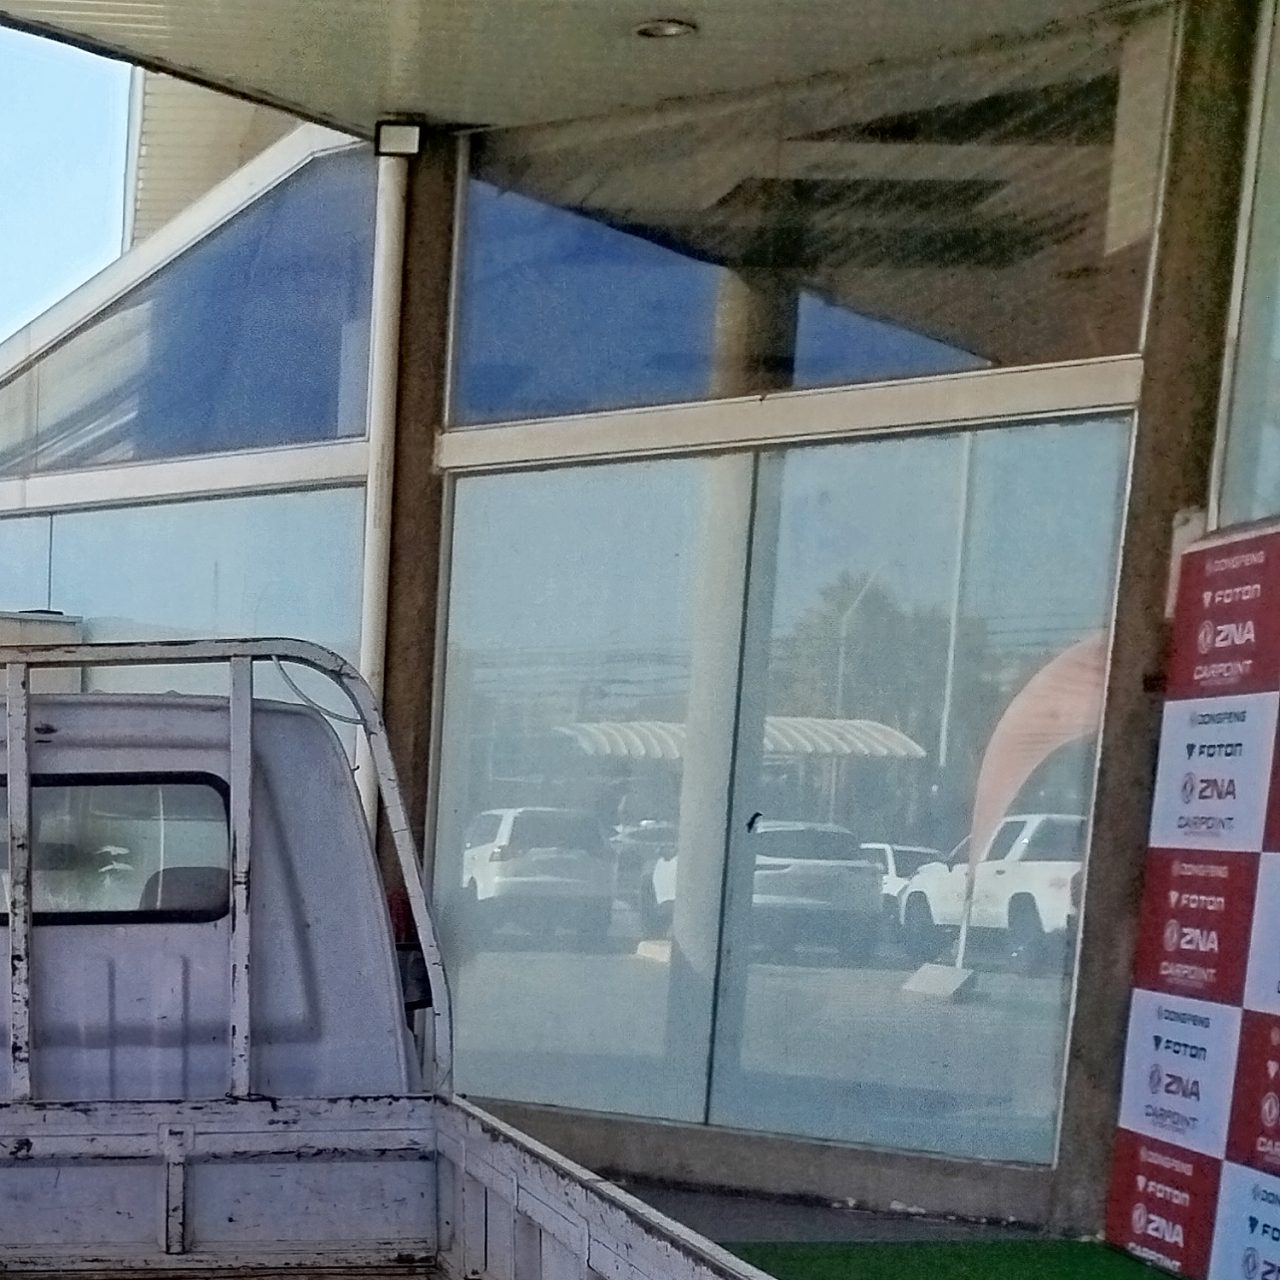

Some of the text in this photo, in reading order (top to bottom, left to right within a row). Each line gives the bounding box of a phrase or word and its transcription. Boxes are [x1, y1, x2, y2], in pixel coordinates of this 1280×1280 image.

[1214, 620, 1255, 648] ZNA
[1198, 778, 1236, 800] ZNA
[1180, 927, 1218, 953] ZNA
[1164, 1073, 1200, 1101] ZNA
[1146, 1213, 1184, 1248] ZNA
